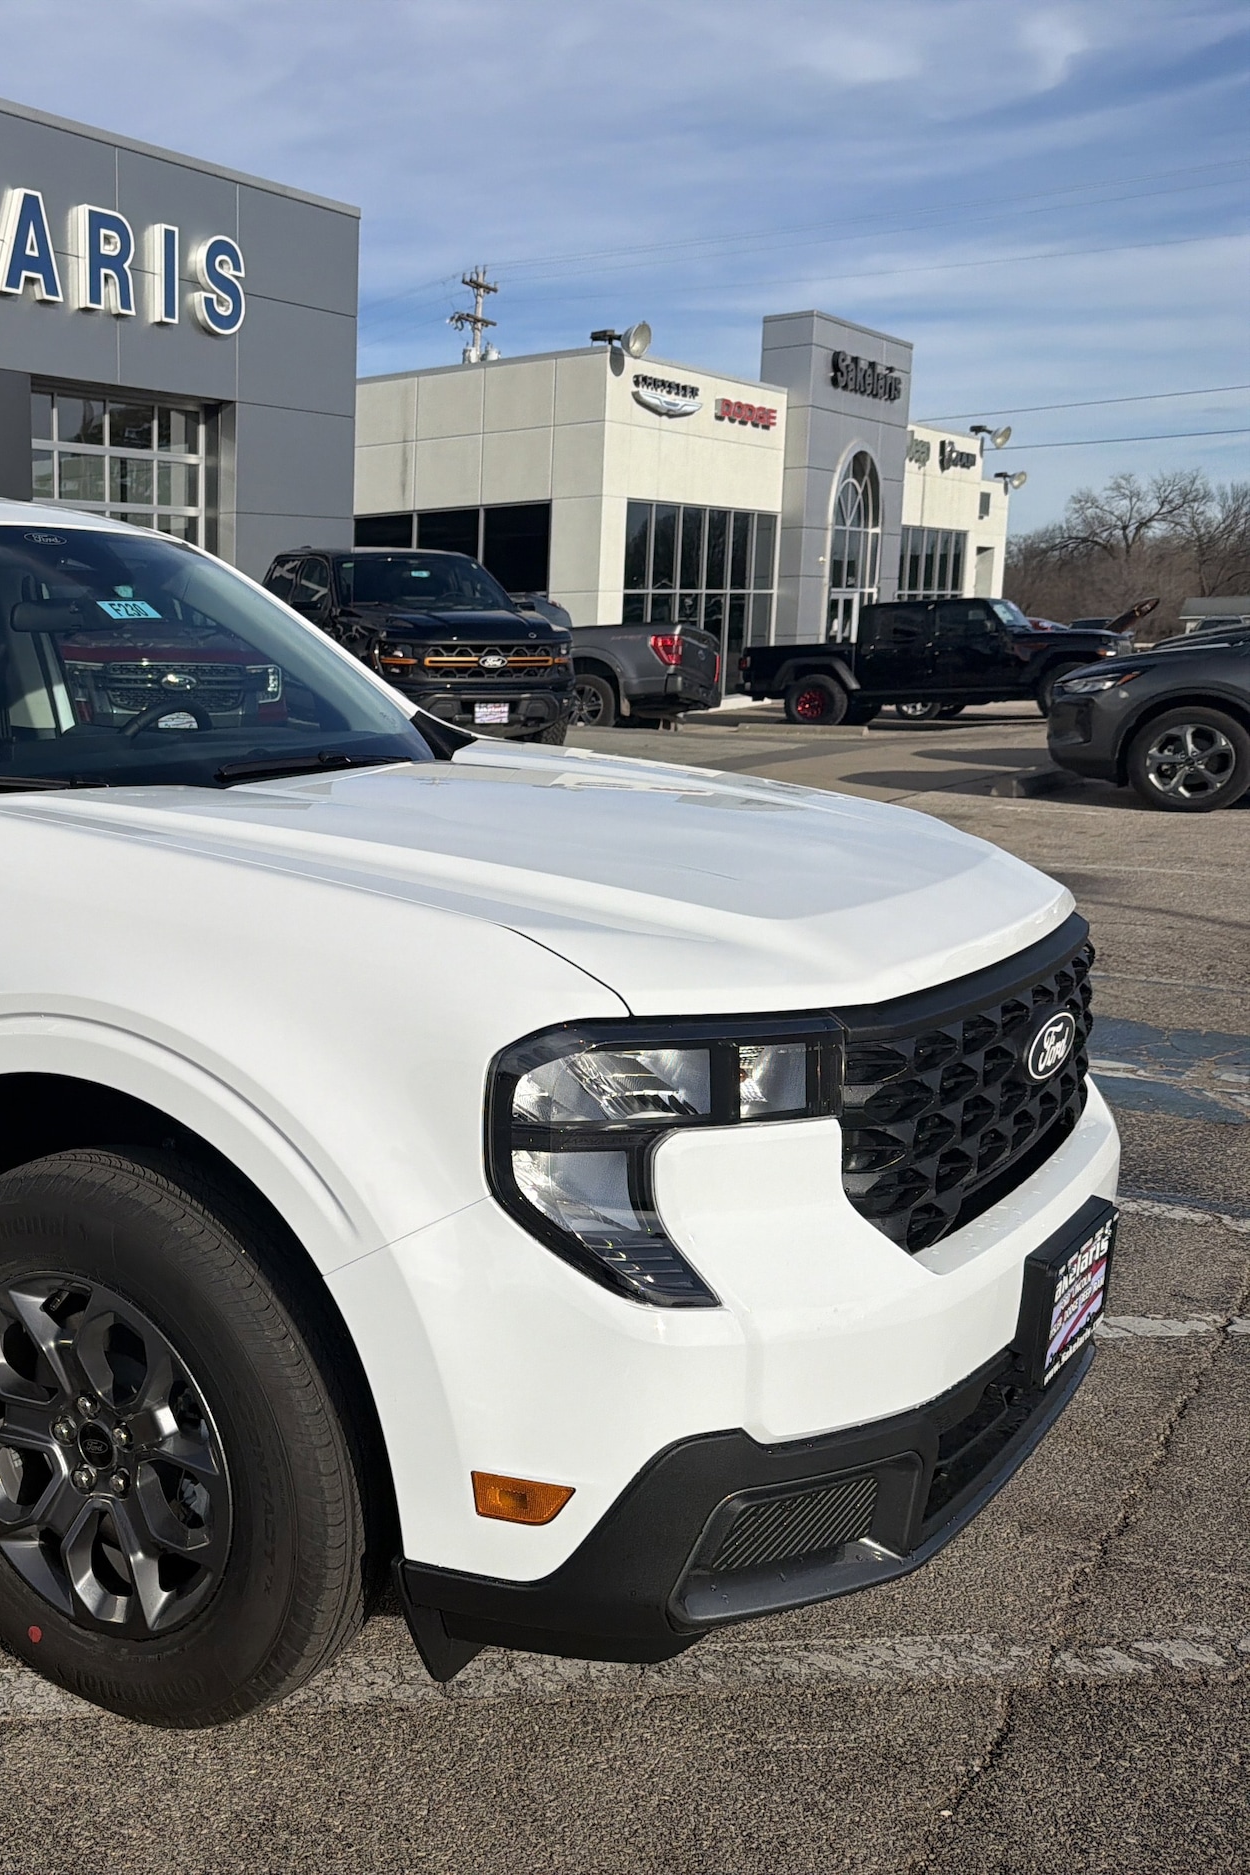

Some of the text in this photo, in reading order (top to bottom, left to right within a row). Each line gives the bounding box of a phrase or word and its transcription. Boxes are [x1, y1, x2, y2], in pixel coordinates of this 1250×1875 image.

[832, 350, 902, 402] Sakelaris
[716, 398, 777, 428] DODGE
[107, 603, 149, 617] F230
[1038, 1022, 1070, 1072] Ford
[1054, 1236, 1109, 1303] akelaris
